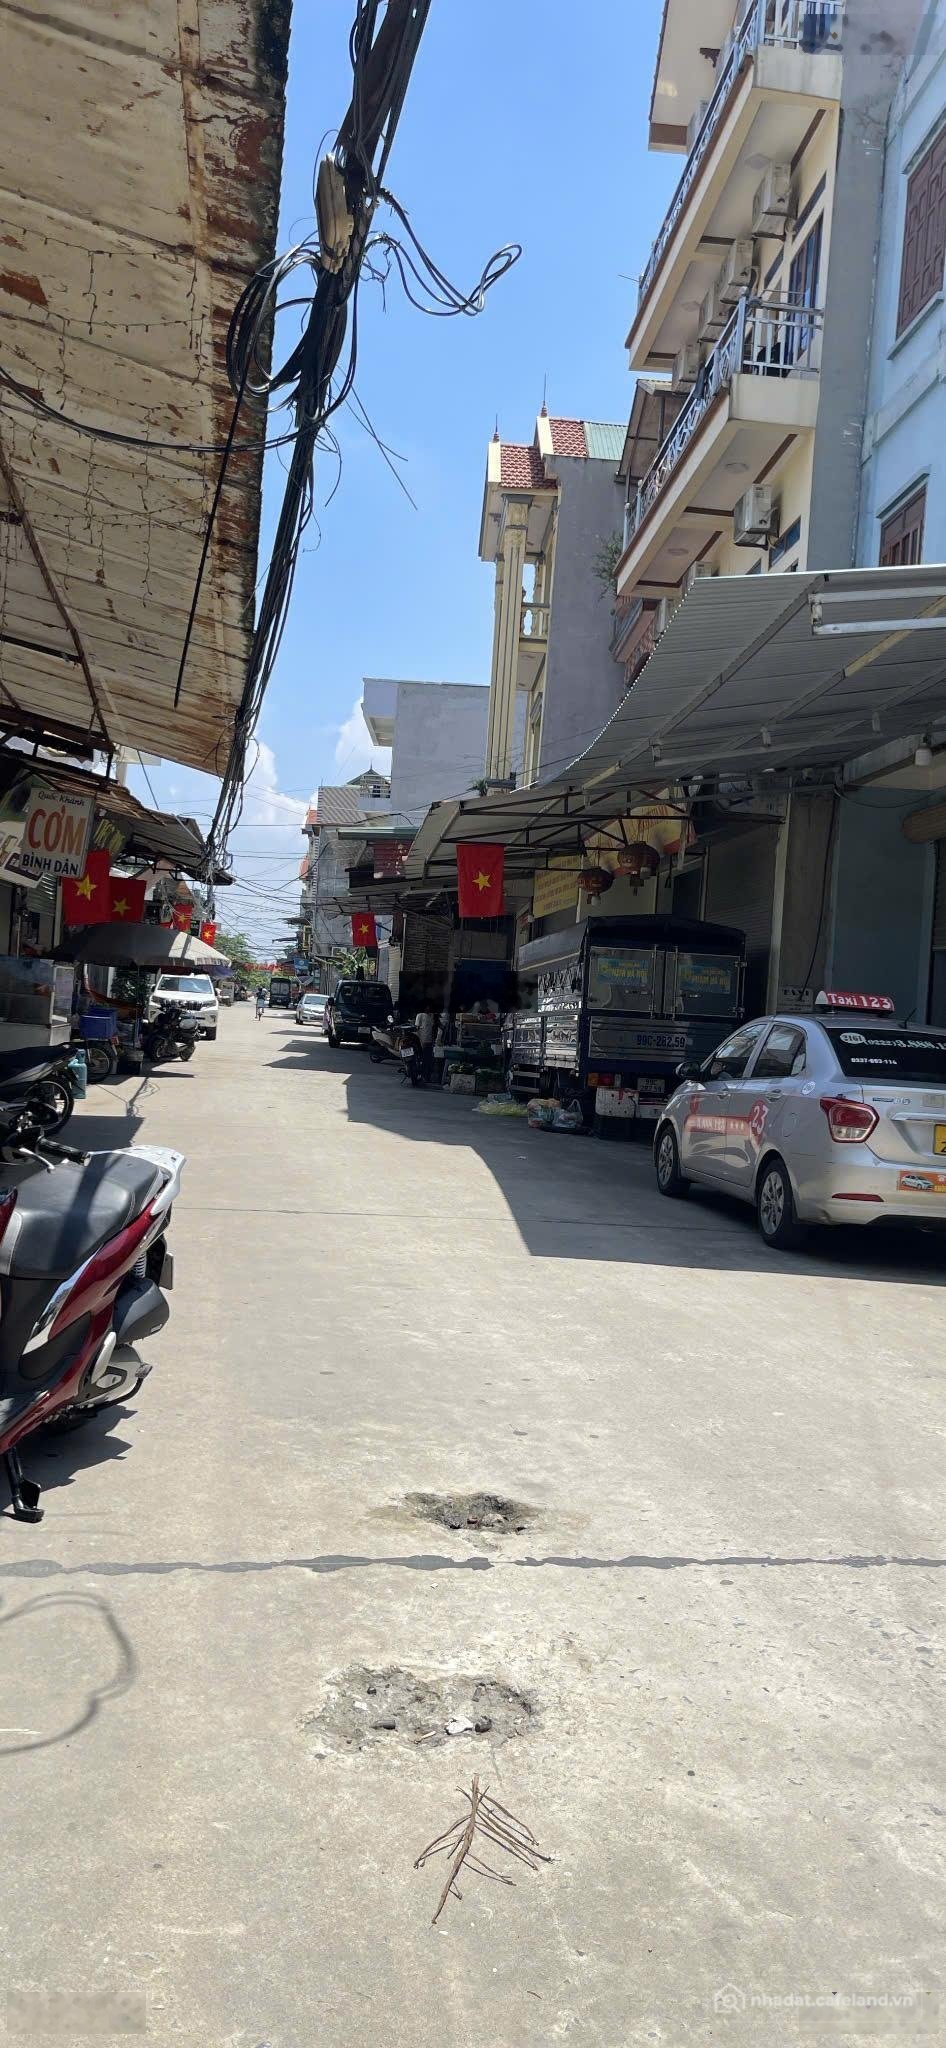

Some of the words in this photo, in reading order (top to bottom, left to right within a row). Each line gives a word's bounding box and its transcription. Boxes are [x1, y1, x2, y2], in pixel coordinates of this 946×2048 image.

[27, 804, 87, 857] CƠM
[22, 851, 52, 872] BÌNH
[53, 857, 79, 876] DÂN
[827, 993, 858, 1007] Taxi
